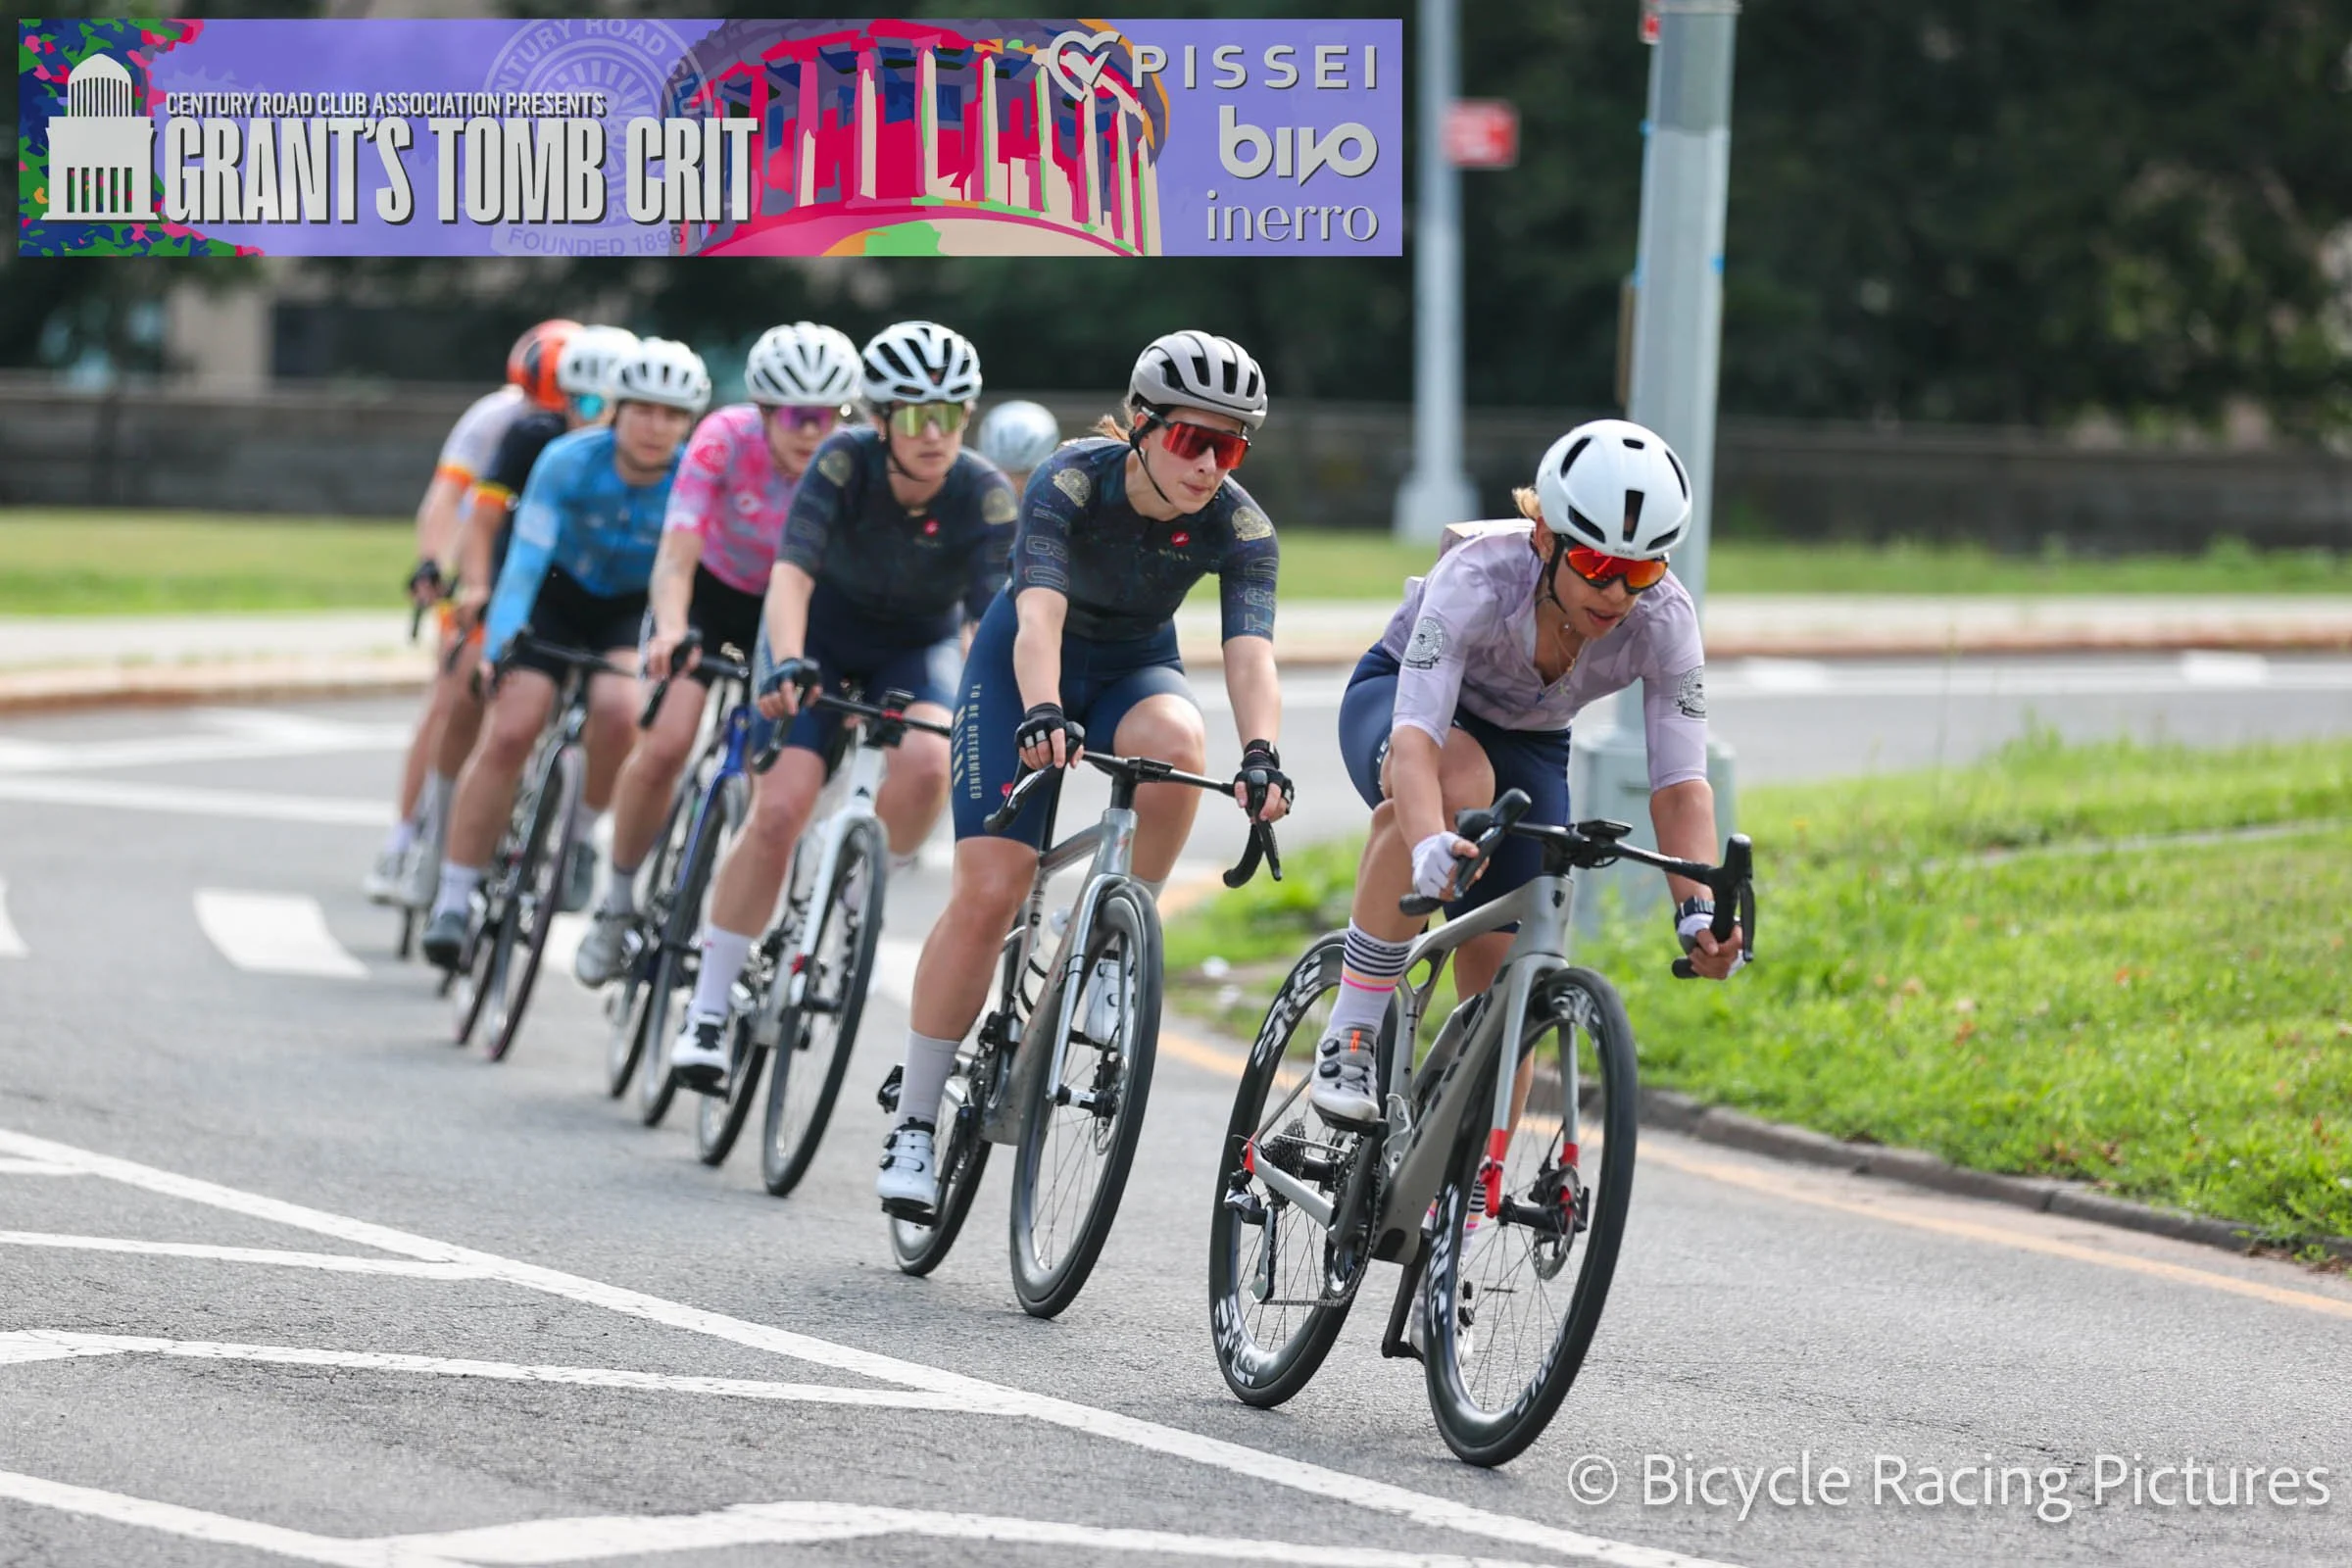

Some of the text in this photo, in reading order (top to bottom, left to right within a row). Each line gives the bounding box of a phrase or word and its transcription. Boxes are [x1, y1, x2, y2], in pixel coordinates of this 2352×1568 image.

[966, 683, 983, 799] TO BE DETERMINED
